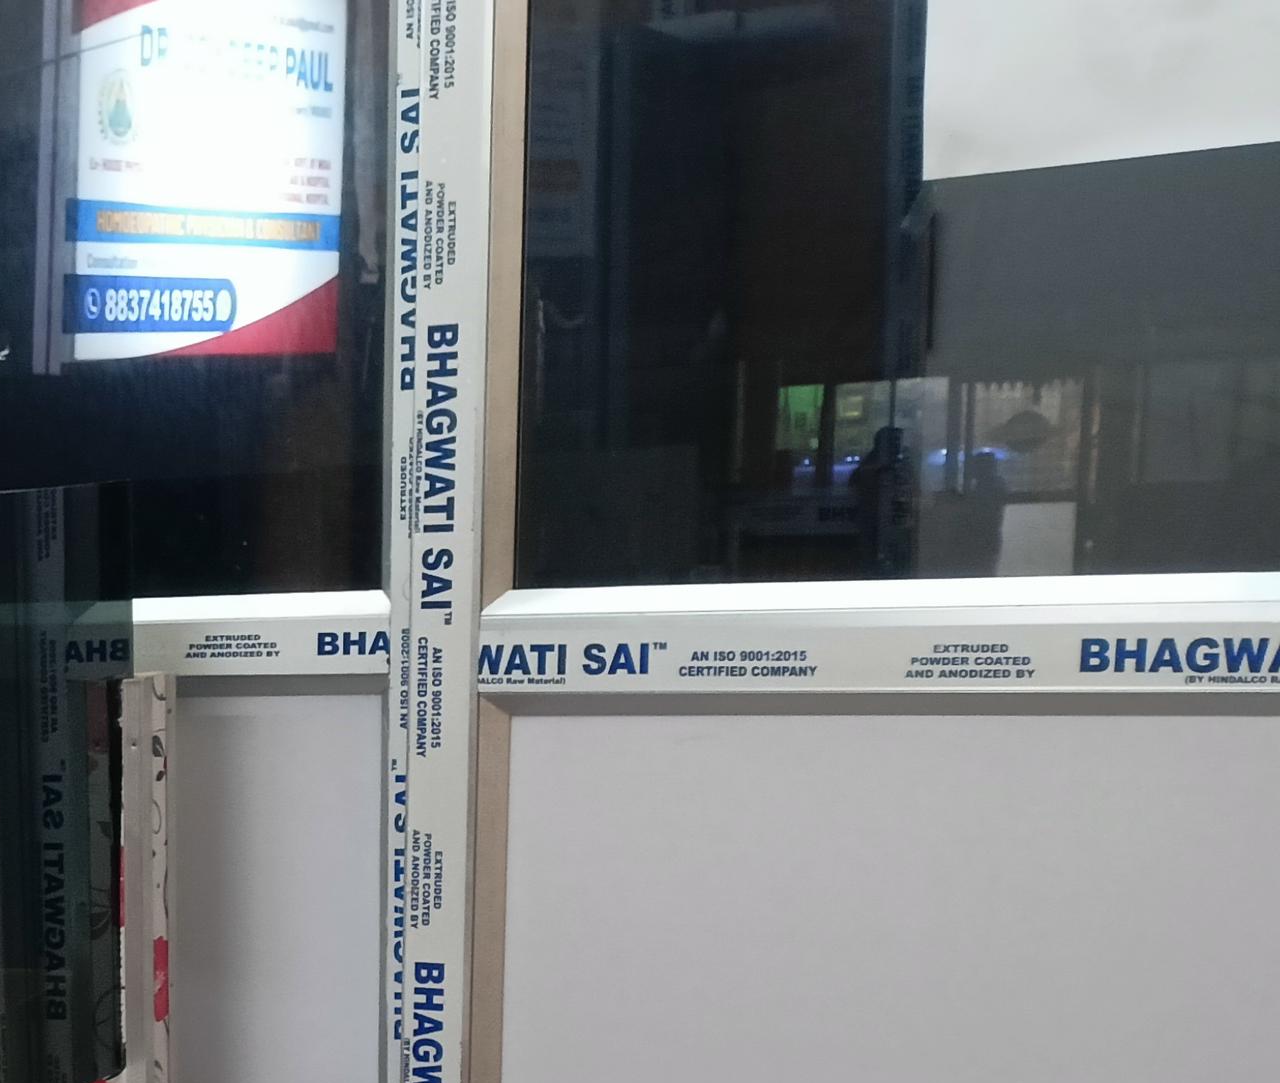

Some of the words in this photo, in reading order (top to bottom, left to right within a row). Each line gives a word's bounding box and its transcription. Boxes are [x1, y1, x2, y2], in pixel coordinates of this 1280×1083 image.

[285, 47, 334, 92] PAUL
[429, 39, 440, 100] COMPANY
[444, 25, 456, 88] 9001:2015
[423, 180, 433, 206] AND
[434, 183, 445, 234] POWDER
[423, 210, 433, 270] ANODIZED
[447, 201, 456, 264] EXTRUDED
[434, 239, 444, 284] COATED
[423, 274, 432, 289] BY
[105, 288, 215, 322] 8837418755
[423, 324, 459, 533] BHAGWATI
[184, 650, 208, 658] AND
[212, 650, 263, 658] ANODIZED
[266, 650, 281, 658] BY
[189, 642, 237, 650] POWDER
[240, 641, 278, 650] COATED
[432, 647, 442, 663] AN
[691, 651, 709, 662] AN
[713, 651, 736, 662] ISO
[739, 650, 807, 662] 9001:2015
[910, 656, 970, 666] POWDER
[974, 656, 1032, 666] COATED
[933, 644, 1009, 653] EXTRUDED
[416, 637, 428, 697] CERTIFIED
[432, 667, 442, 686] ISO
[678, 665, 747, 677] CERTIFIED
[751, 664, 818, 677] COMPANY
[905, 669, 934, 679] AND
[938, 668, 1011, 679] ANODIZED
[1015, 668, 1036, 679] BY
[415, 701, 428, 757] COMPANY
[430, 691, 442, 748] 9001:2015
[411, 830, 421, 852] AND
[422, 833, 432, 884] POWDER
[410, 855, 420, 912] ANODIZED
[433, 851, 442, 909] EXTRUDED
[410, 915, 419, 929] BY
[422, 887, 431, 926] COATED
